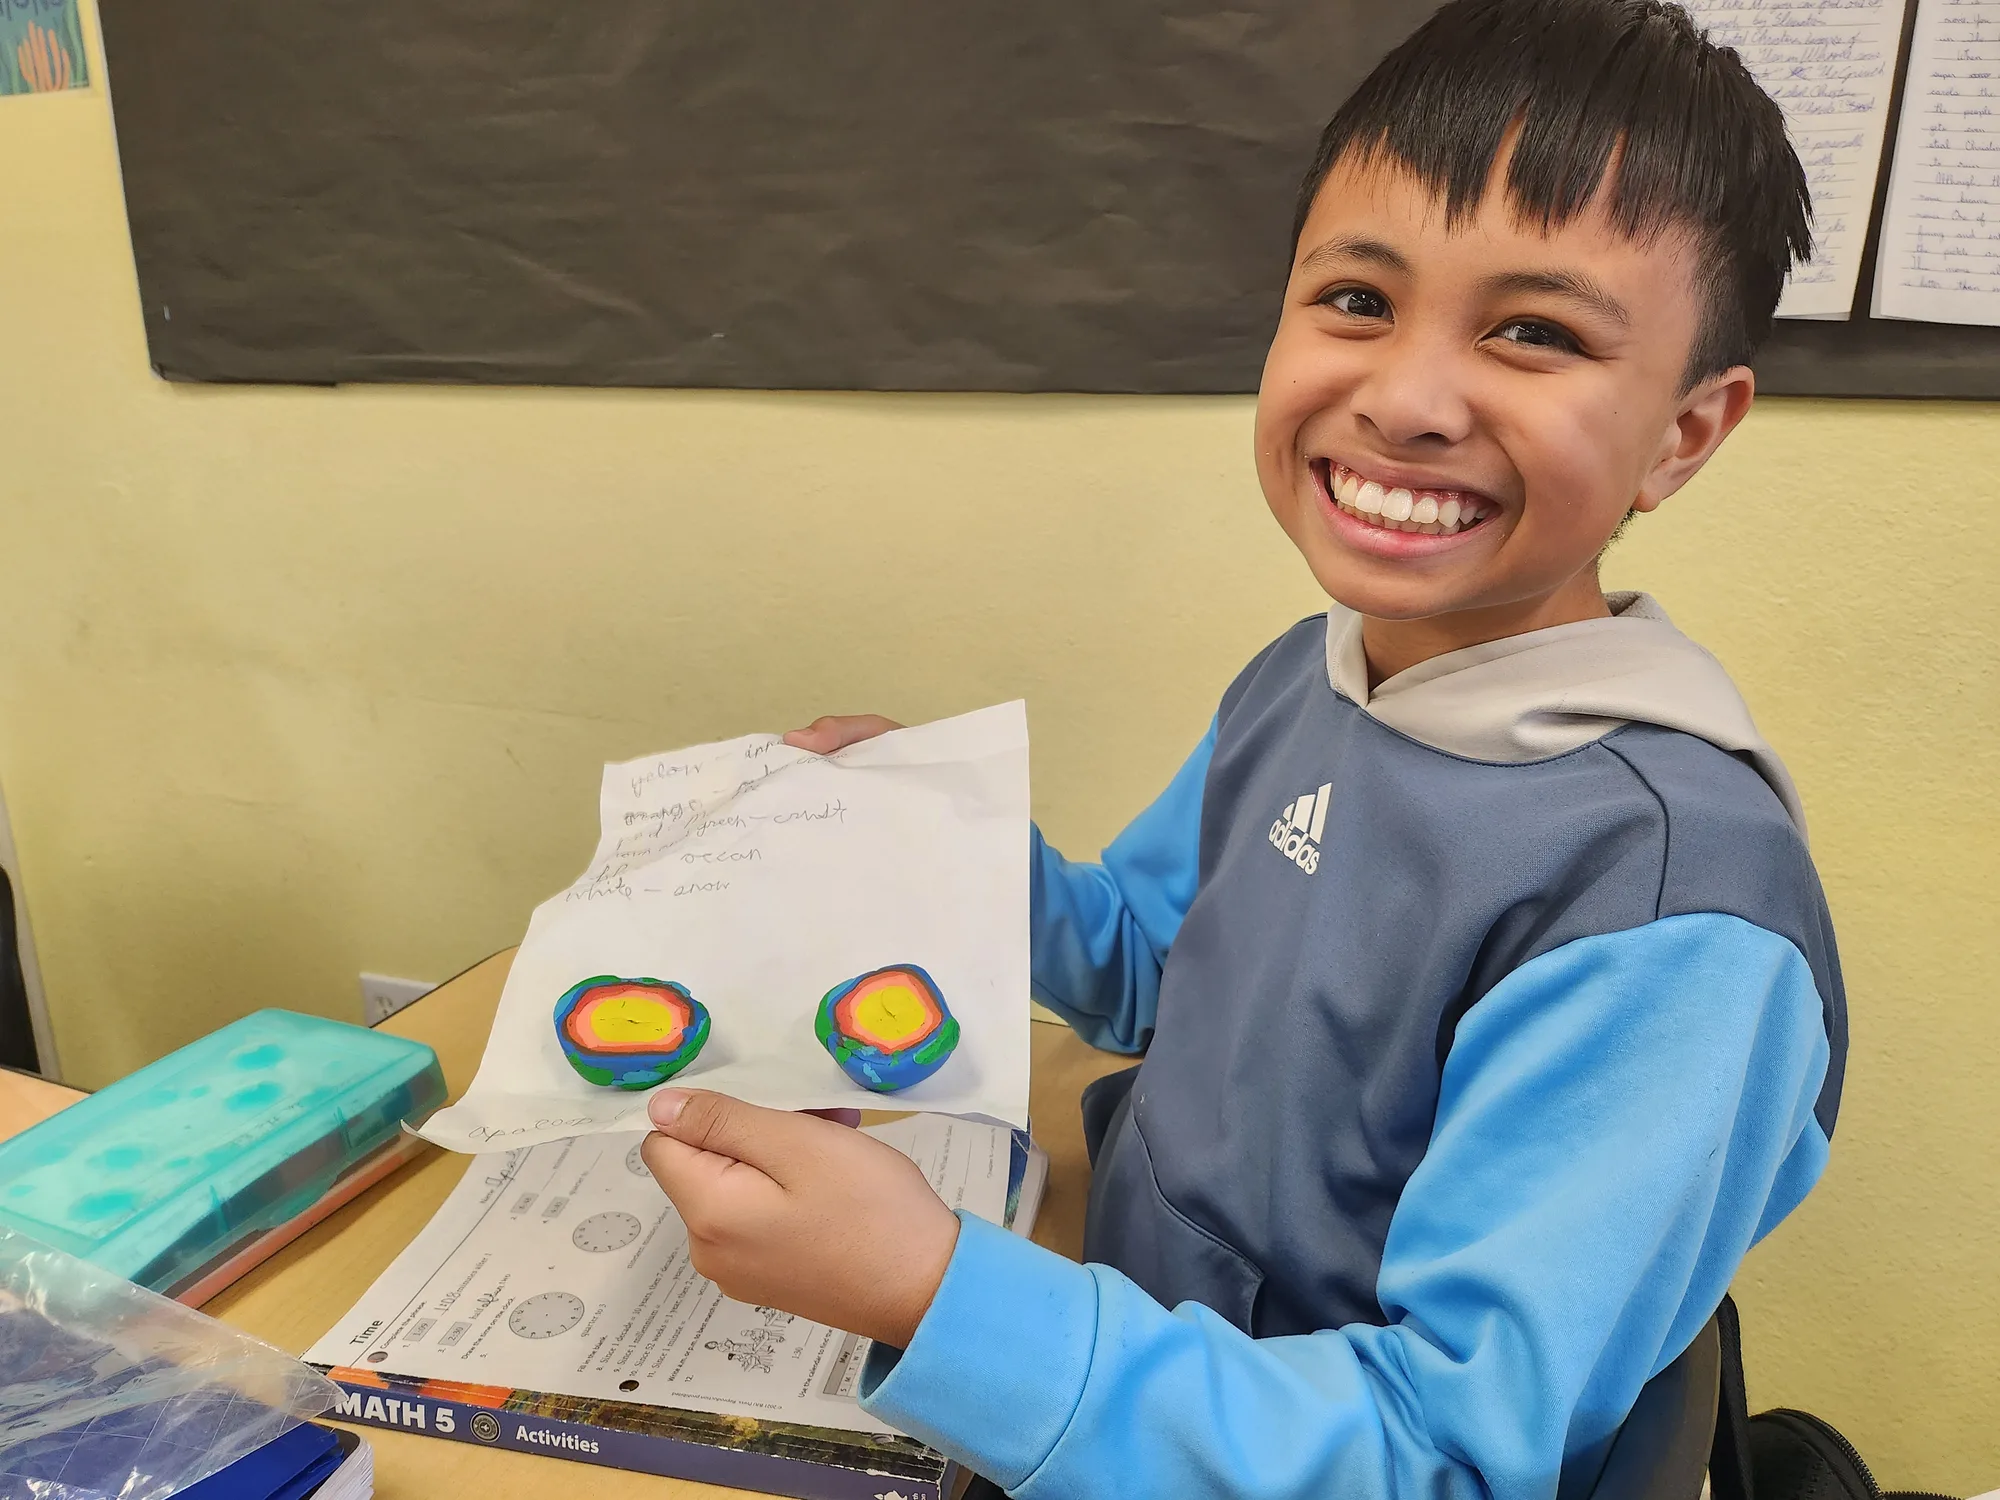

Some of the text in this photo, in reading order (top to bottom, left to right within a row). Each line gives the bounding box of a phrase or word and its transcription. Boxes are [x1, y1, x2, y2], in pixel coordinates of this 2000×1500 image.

[1268, 819, 1320, 875] adidas
[350, 1318, 383, 1346] Time
[379, 1326, 404, 1350] Complete
[447, 1326, 464, 1342] 2:30
[580, 1315, 599, 1338] quarter
[616, 1349, 634, 1365] Since
[633, 1309, 659, 1344] millennium
[460, 1346, 476, 1360] Draw
[599, 1347, 617, 1364] Since
[615, 1321, 634, 1342] decade
[633, 1350, 651, 1367] Since
[651, 1324, 667, 1342] weeks
[651, 1352, 668, 1369] Since
[667, 1326, 684, 1347] minute
[808, 1355, 822, 1378] calendar
[838, 1351, 851, 1364] May
[336, 1393, 426, 1429] MATH
[435, 1408, 456, 1433] 5
[700, 1395, 737, 1405] Reproduction
[515, 1425, 600, 1454] Activities
